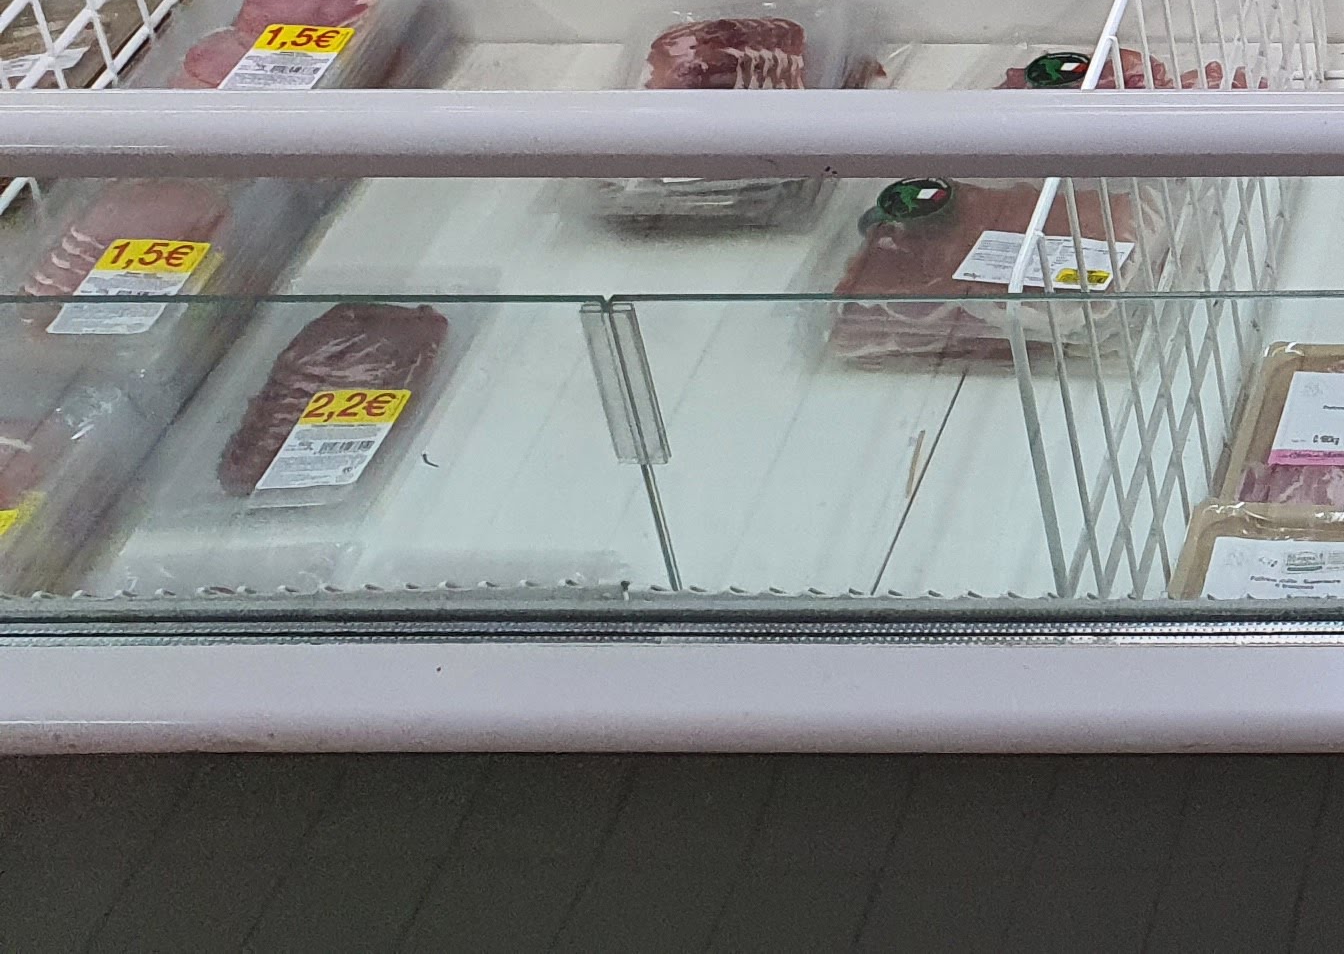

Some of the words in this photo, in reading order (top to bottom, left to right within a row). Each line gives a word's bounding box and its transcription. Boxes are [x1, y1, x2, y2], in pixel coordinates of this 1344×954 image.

[266, 26, 341, 50] 1,5€
[111, 241, 195, 269] 1,5€
[302, 391, 397, 423] 2,2€
